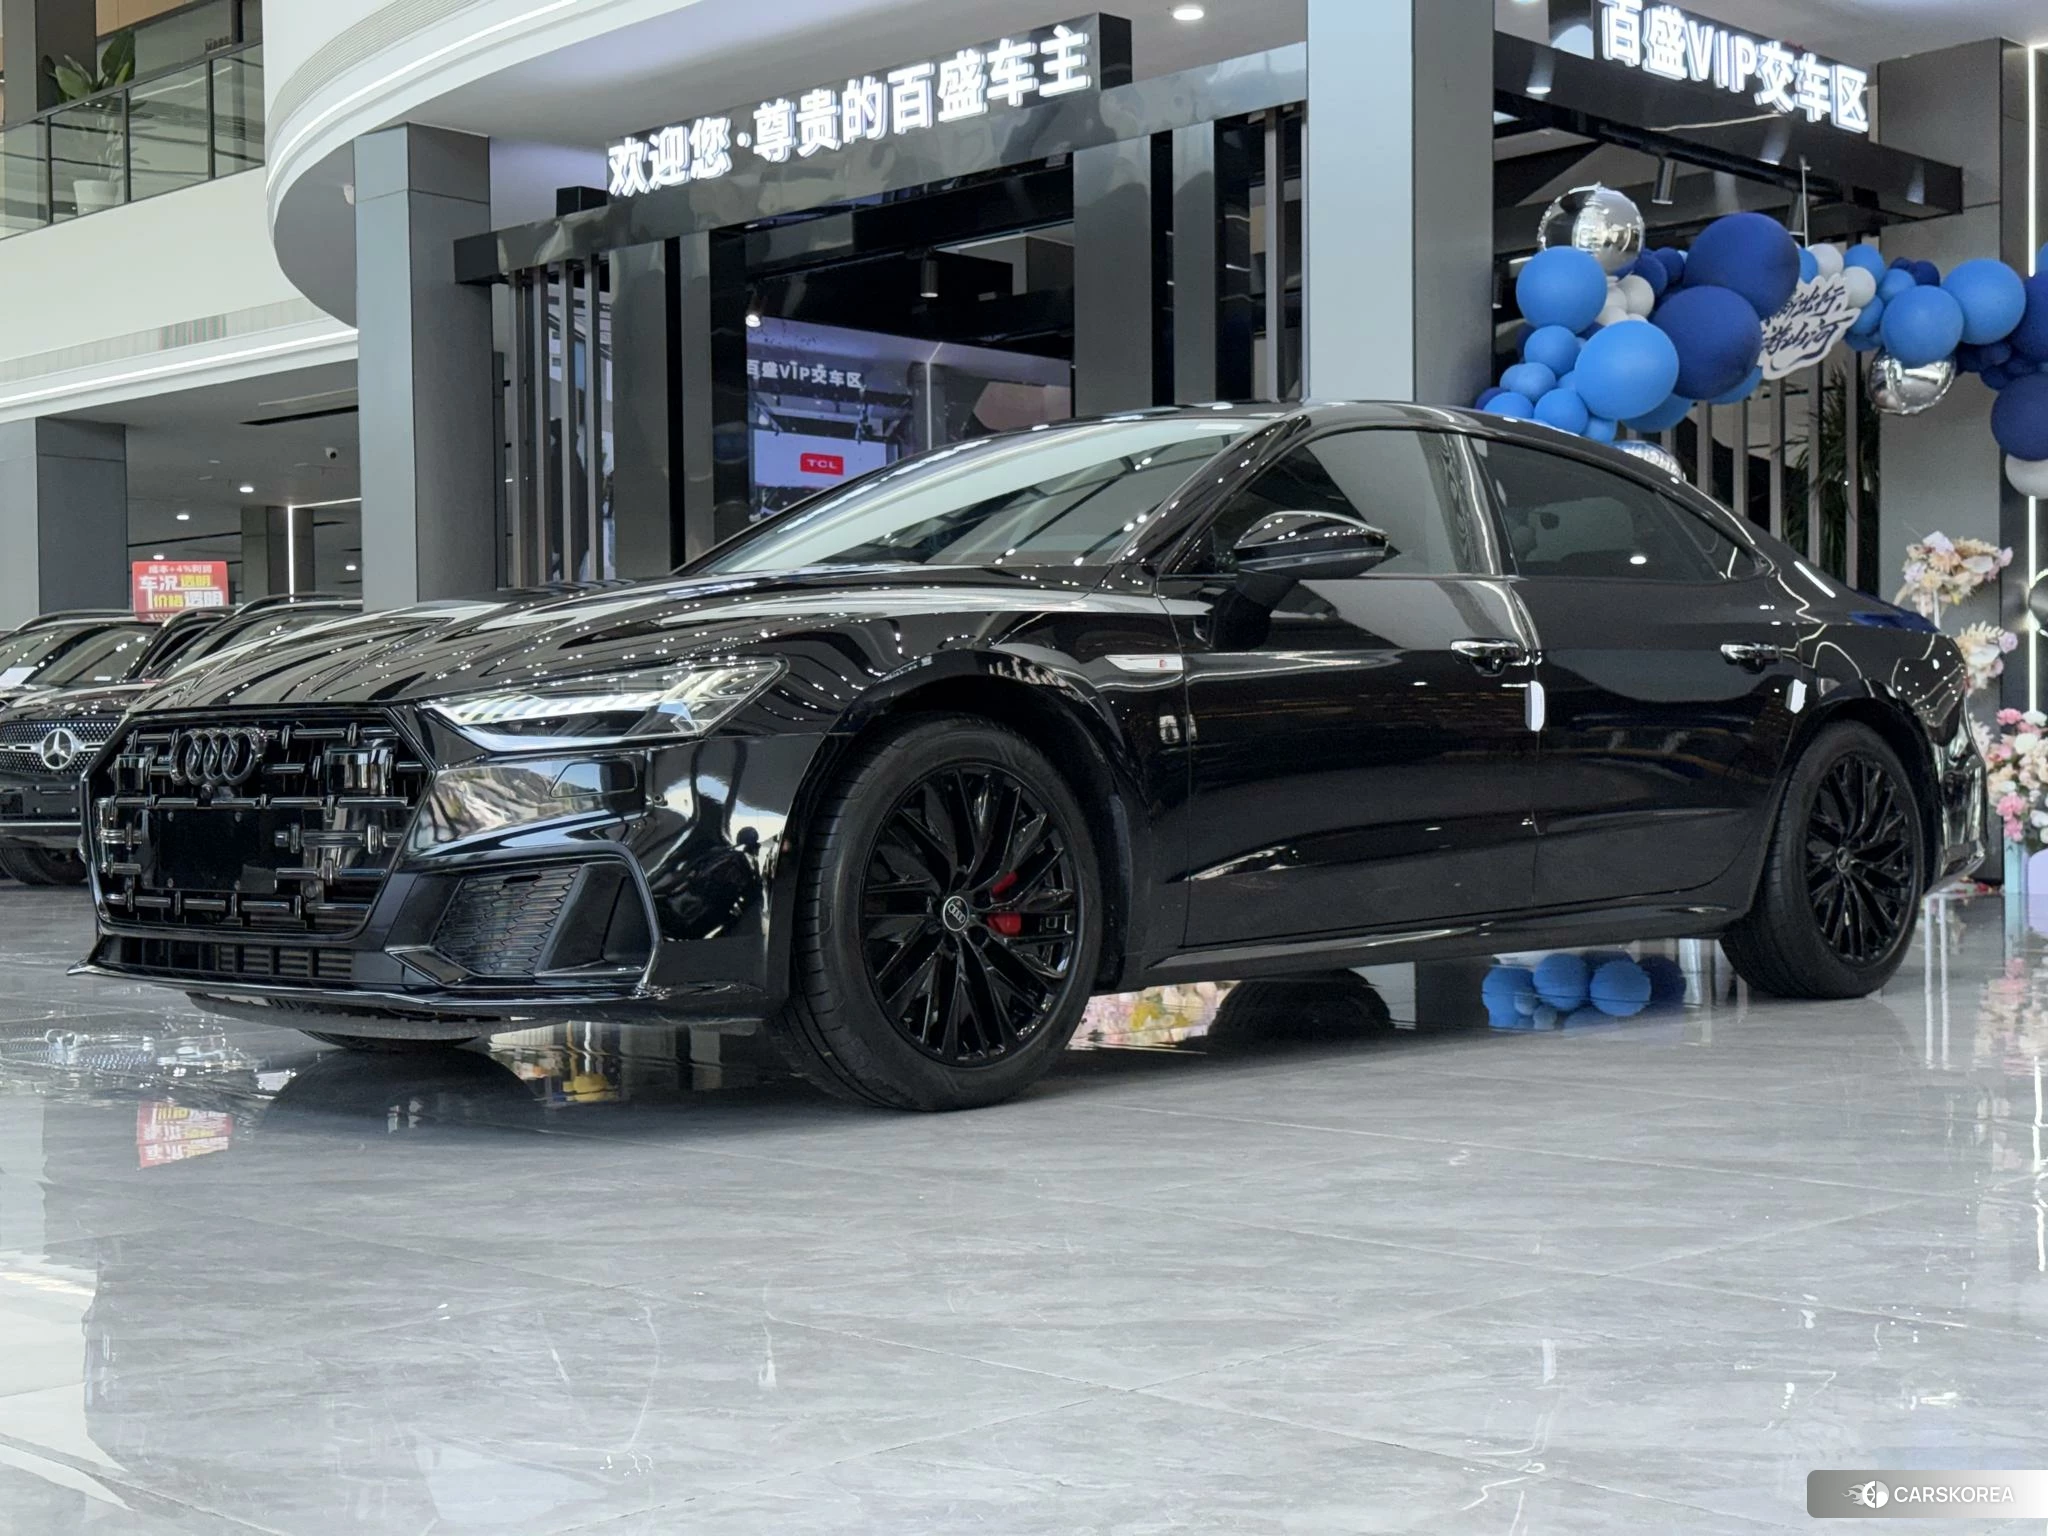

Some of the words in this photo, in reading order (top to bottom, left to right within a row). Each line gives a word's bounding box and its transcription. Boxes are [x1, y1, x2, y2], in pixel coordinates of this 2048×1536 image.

[607, 25, 1092, 198] 欢迎您·尊贵的百盛车主
[1600, 0, 1869, 134] 百盛VIP交车区
[807, 459, 837, 470] TCL
